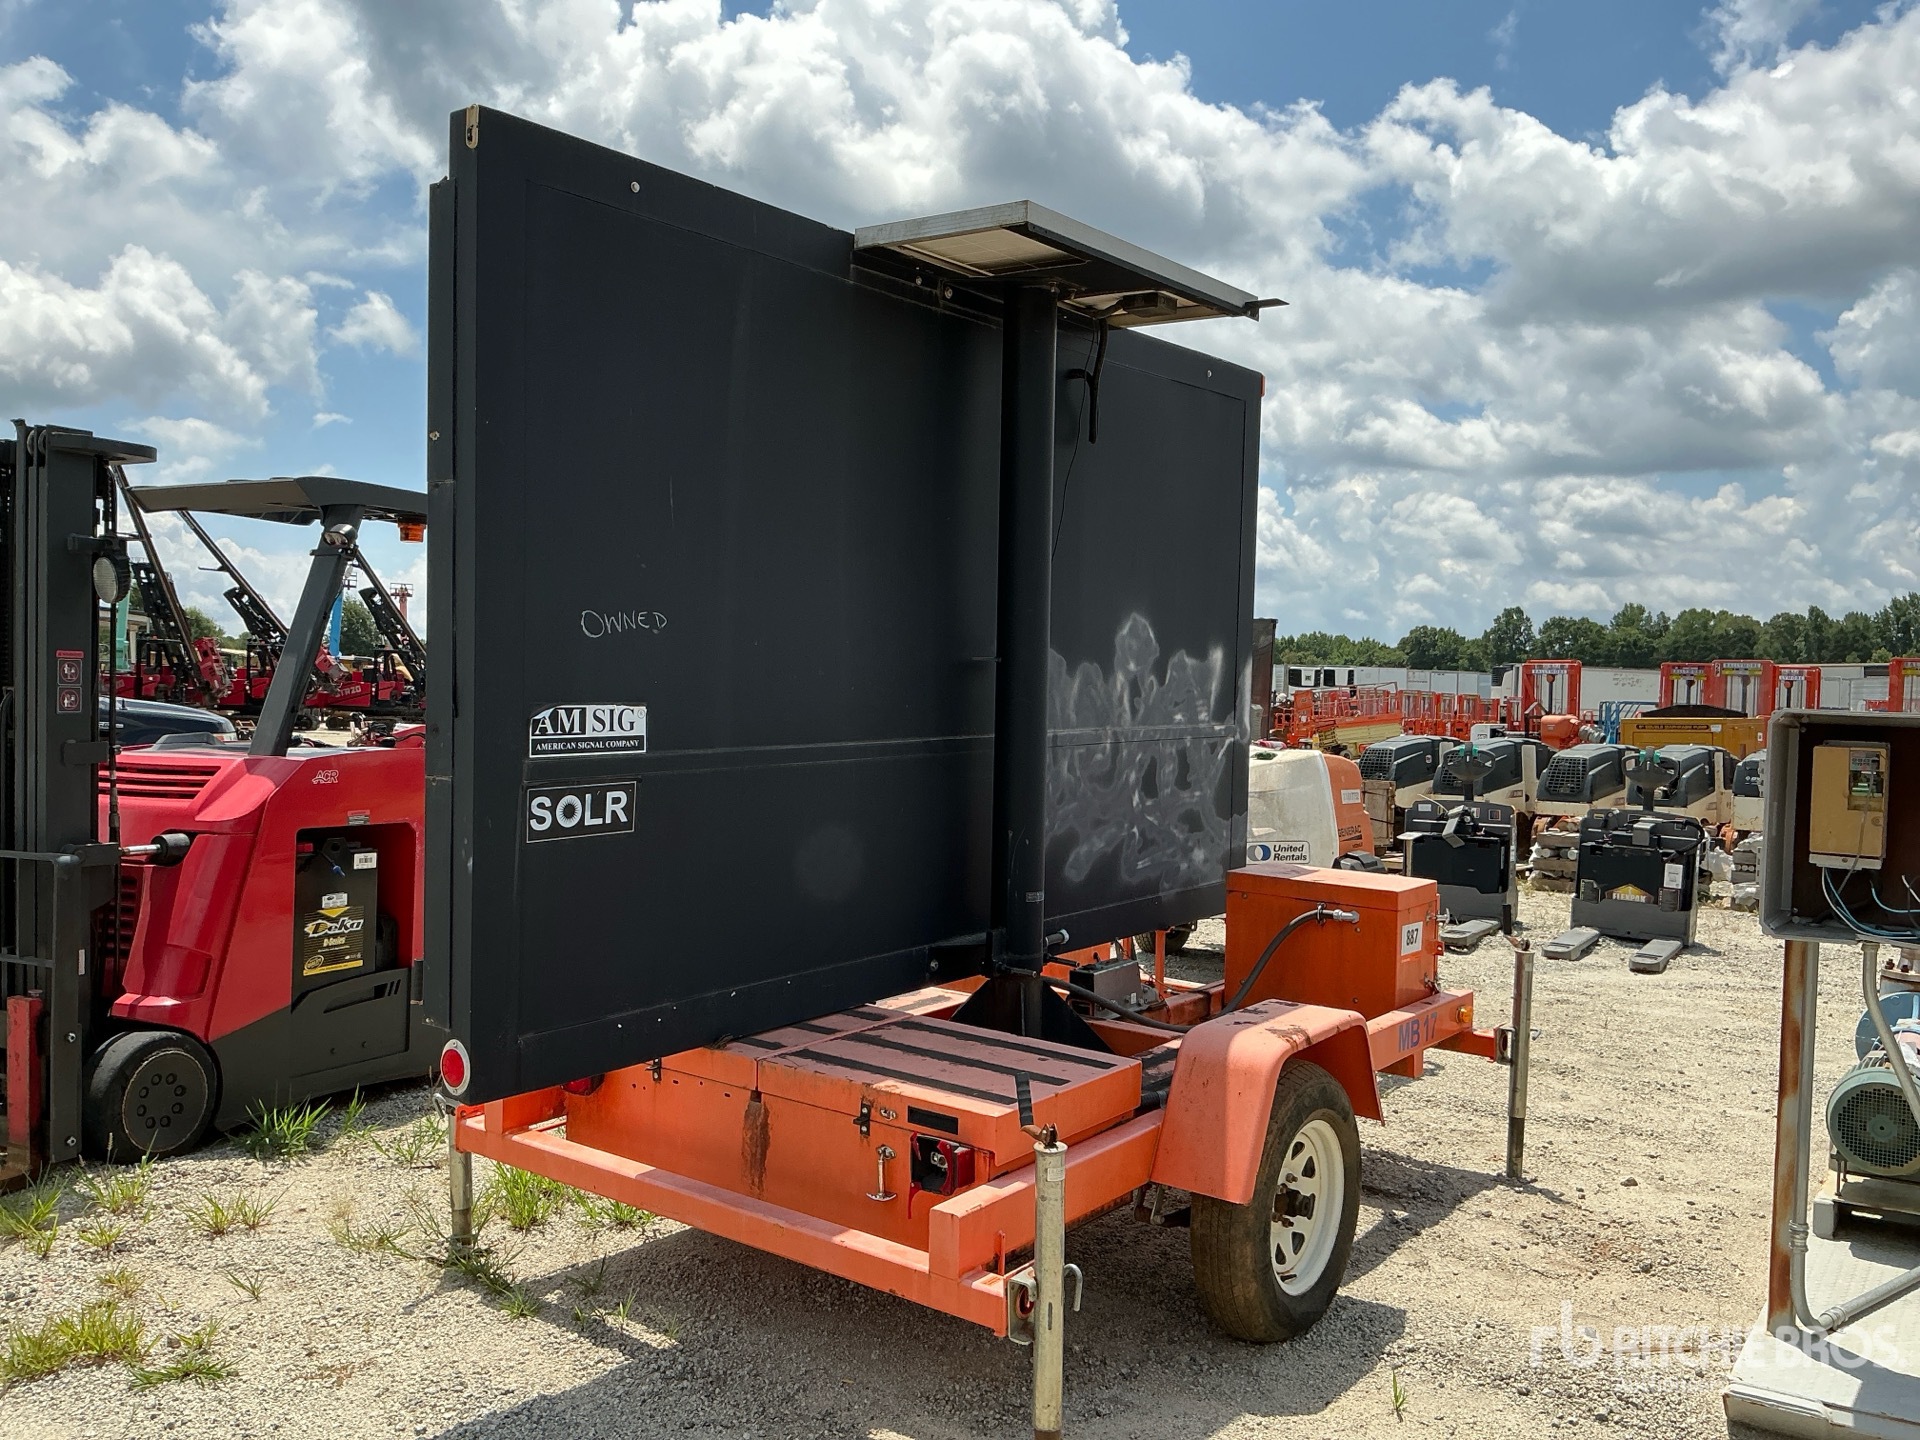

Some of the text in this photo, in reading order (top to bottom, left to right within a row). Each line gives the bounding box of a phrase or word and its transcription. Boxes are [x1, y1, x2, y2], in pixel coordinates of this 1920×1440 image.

[580, 609, 668, 638] OWNED
[534, 707, 636, 736] AM SIG
[535, 738, 640, 751] AMERICAN SIGNAL COMPANY
[311, 769, 339, 785] ACR
[529, 790, 628, 832] SOLR
[1338, 824, 1362, 838] GENERAC
[1273, 844, 1304, 853] United
[1273, 853, 1308, 861] Rentals
[304, 916, 364, 938] Deka
[1406, 927, 1419, 946] 887
[1398, 1011, 1438, 1053] MB 17
